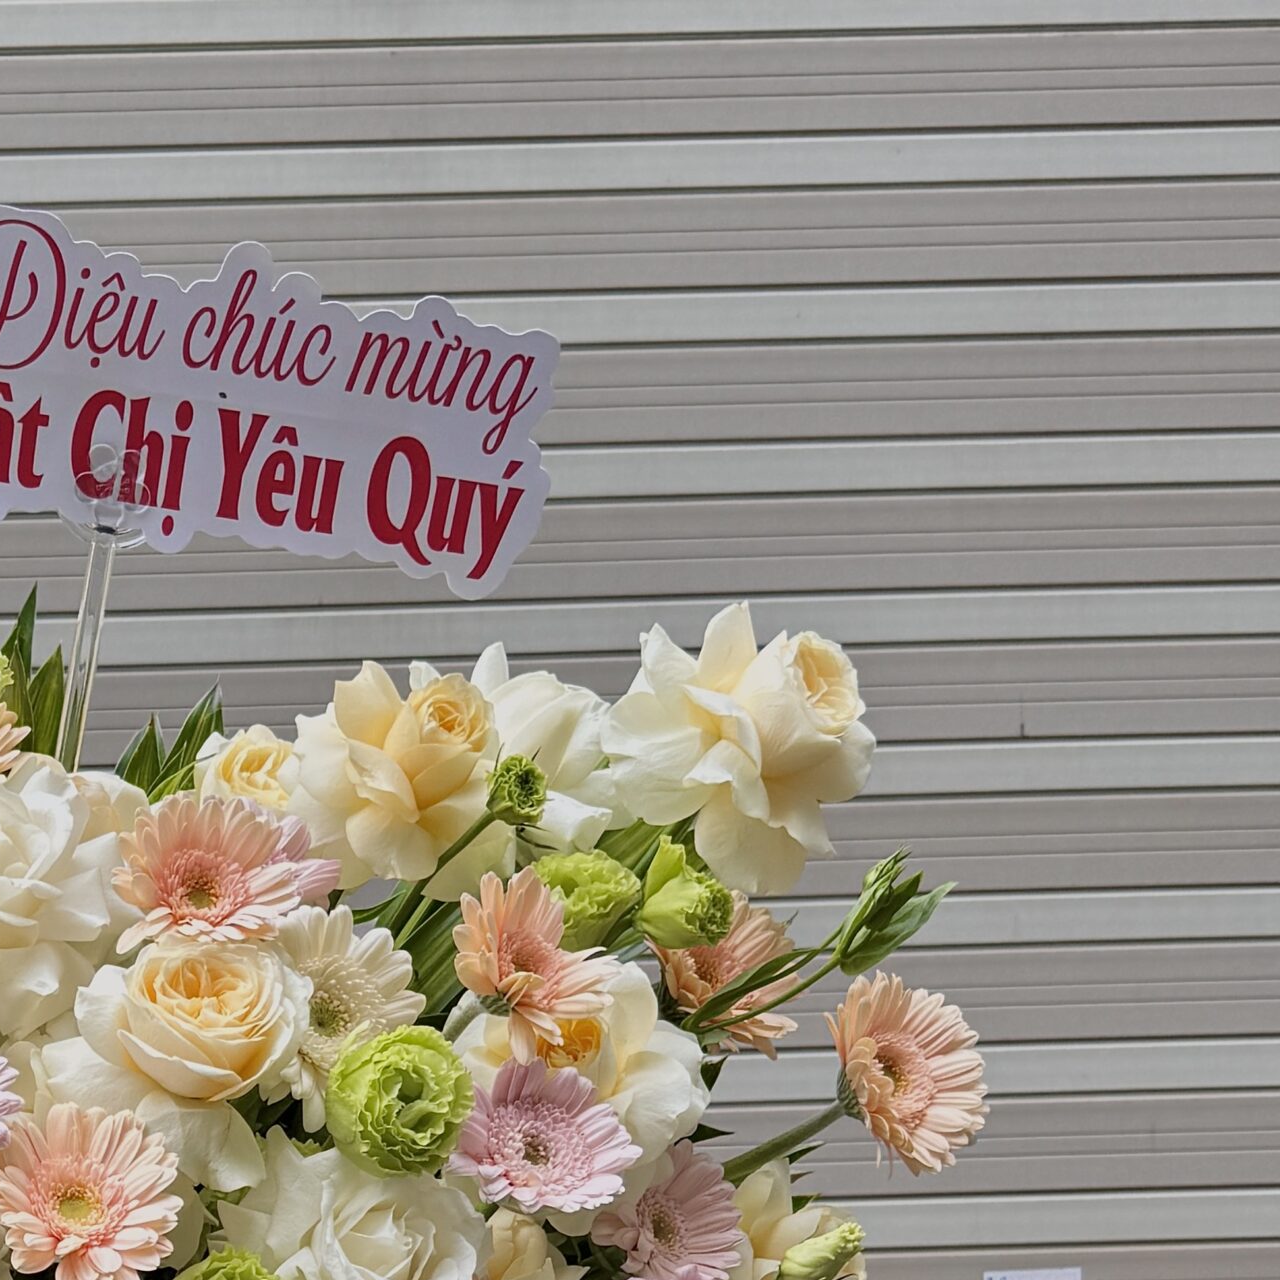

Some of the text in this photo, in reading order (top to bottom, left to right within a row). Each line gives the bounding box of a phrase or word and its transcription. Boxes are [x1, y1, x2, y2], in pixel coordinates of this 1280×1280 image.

[181, 269, 337, 387] chúc
[344, 319, 539, 455] mừng
[70, 389, 195, 538] Chị
[215, 408, 345, 536] Yêu
[366, 436, 526, 581] Quý
